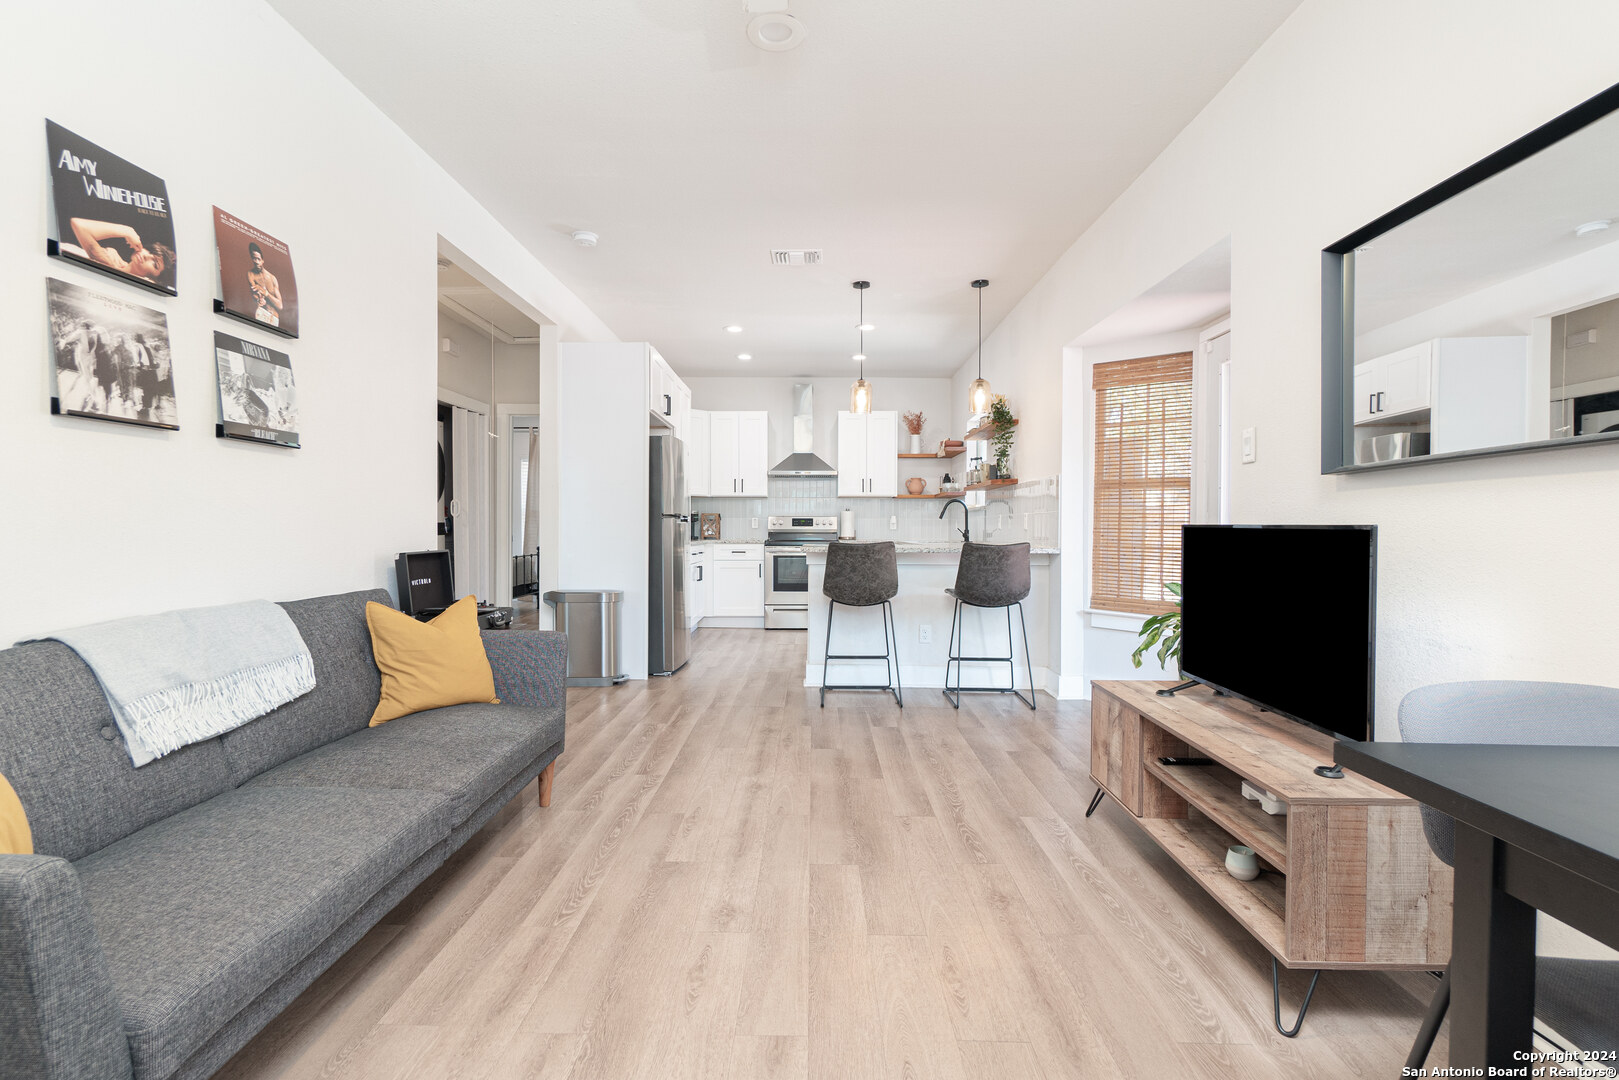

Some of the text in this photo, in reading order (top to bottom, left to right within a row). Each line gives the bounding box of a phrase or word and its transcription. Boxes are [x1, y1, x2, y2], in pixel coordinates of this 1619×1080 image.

[58, 149, 97, 176] AMY
[82, 175, 167, 213] WINEHOUSE
[240, 340, 271, 361] NIRVANA
[411, 578, 432, 586] VICTROLA
